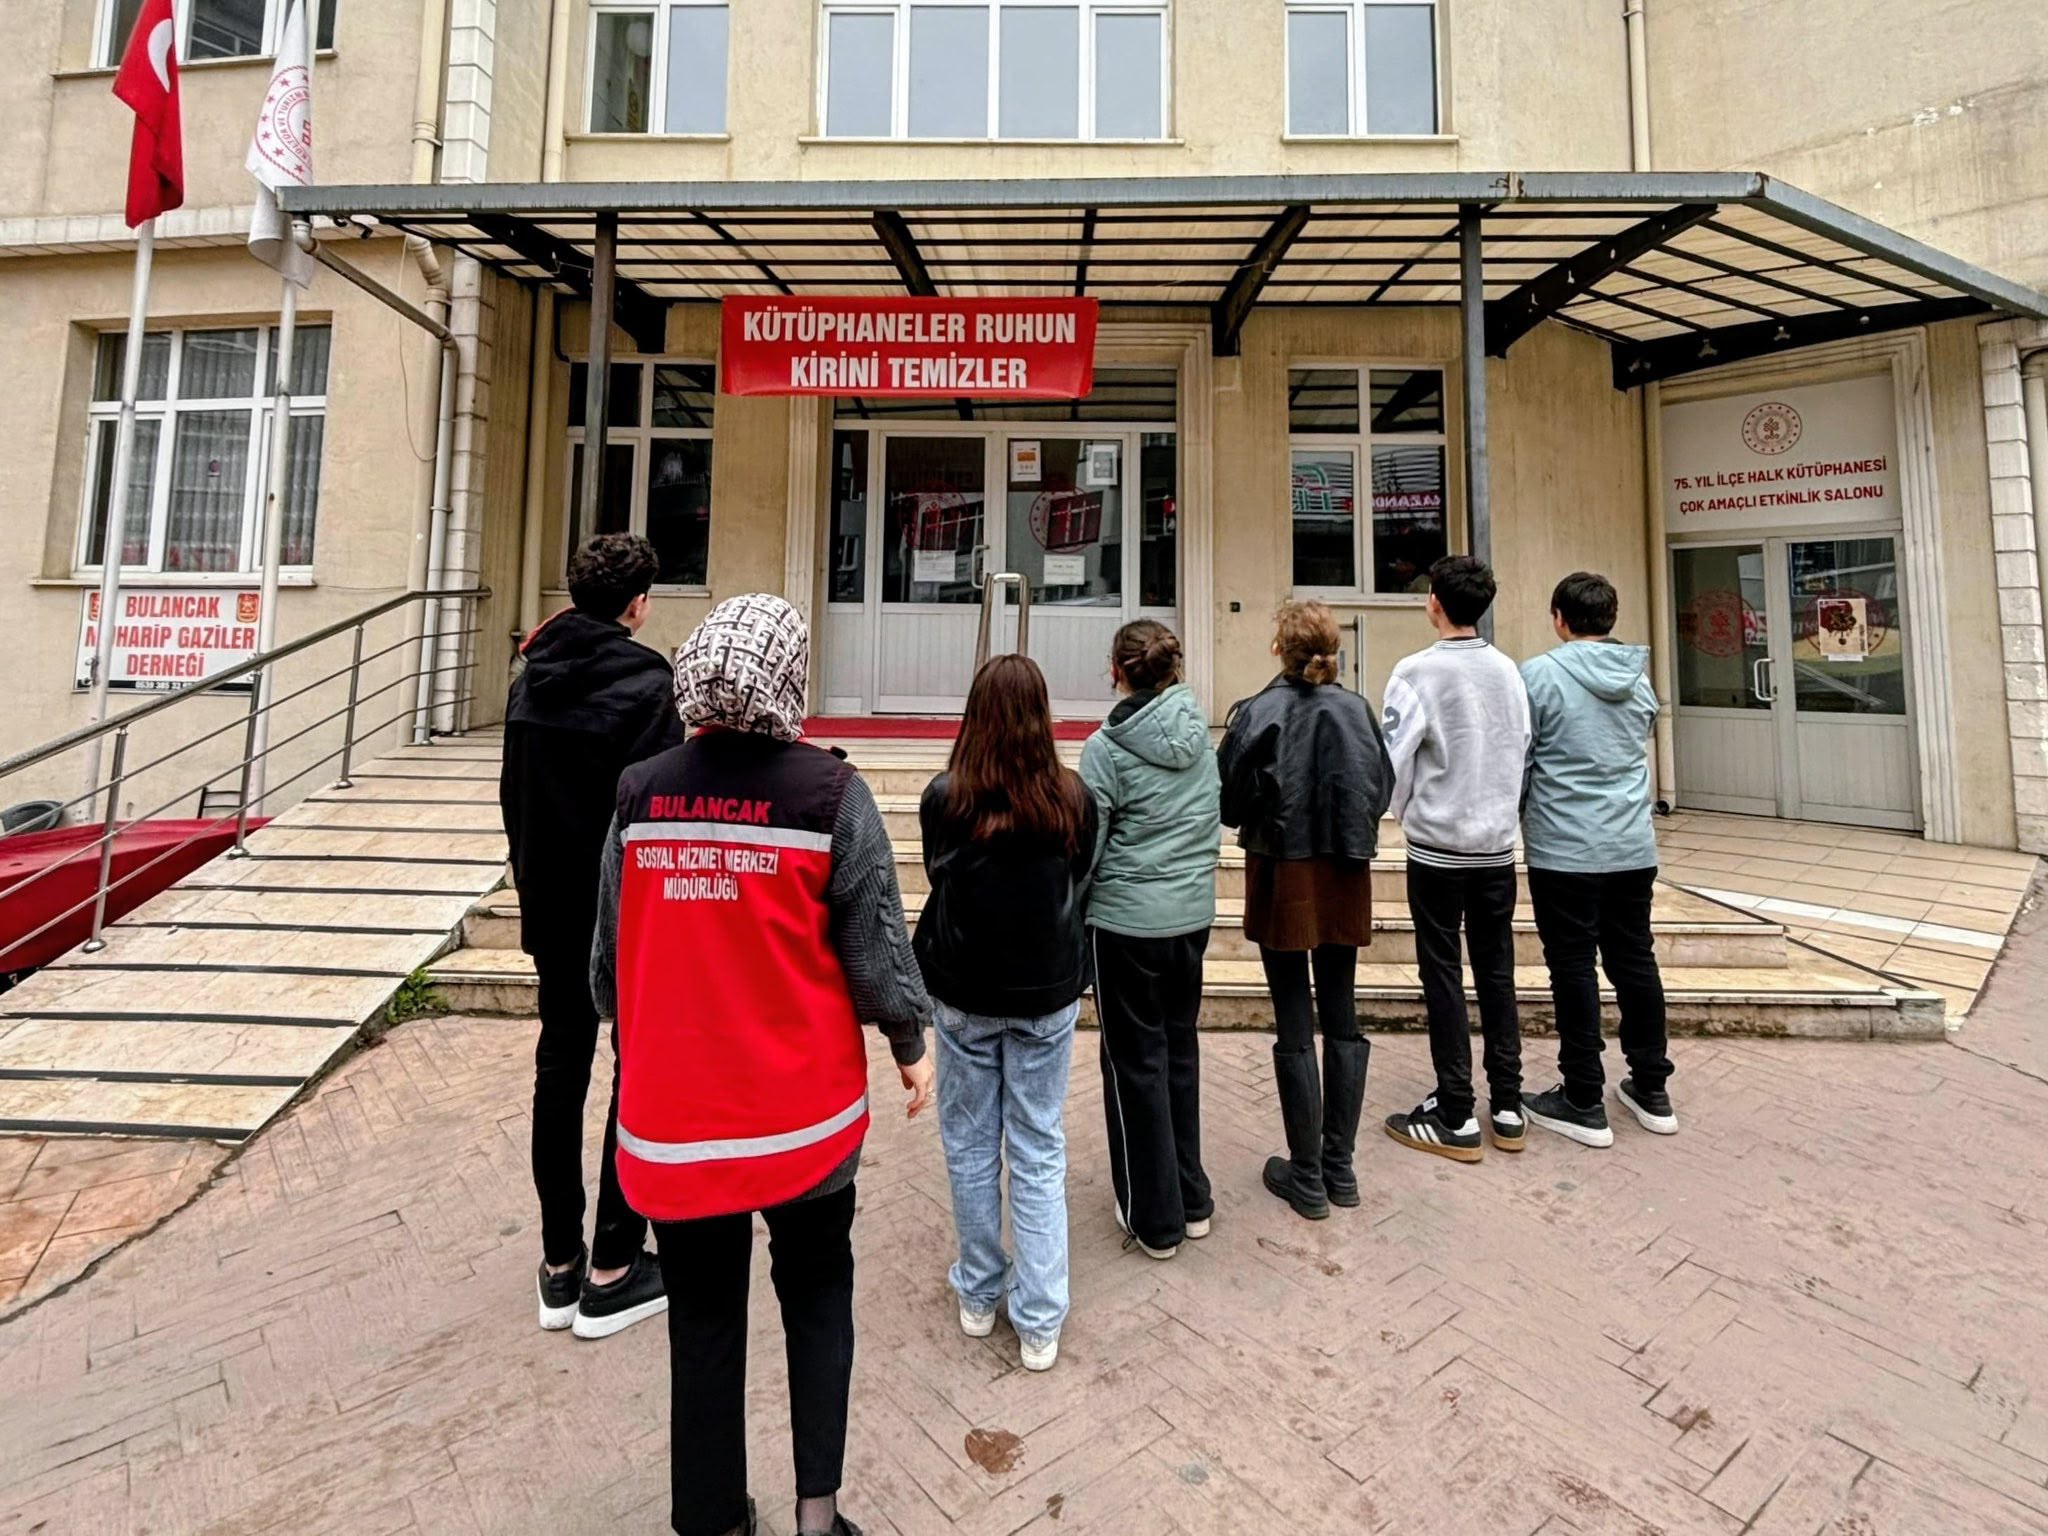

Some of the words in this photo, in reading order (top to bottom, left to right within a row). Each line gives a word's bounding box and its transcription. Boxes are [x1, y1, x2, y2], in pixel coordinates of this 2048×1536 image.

[743, 306, 966, 342] KÜTÜPHANELER
[975, 312, 1076, 343] RUHUN
[790, 351, 879, 388] KİRİNİ
[888, 351, 1027, 389] TEMİZLER
[1674, 478, 1692, 490] 75.
[1694, 475, 1714, 488] YIL
[1717, 471, 1745, 487] İLÇE
[1748, 468, 1783, 484] HALK
[1786, 455, 1888, 480] KÜTÜPHANESİ
[1680, 500, 1705, 515] ÇOK
[1707, 495, 1757, 511] AMAÇLI
[1759, 488, 1821, 507] ETKİNLİK
[1824, 484, 1884, 501] SALONU
[125, 595, 221, 618] BULANCAK
[84, 623, 172, 649] MHARİP
[177, 623, 256, 650] GAZİLER
[126, 652, 206, 677] DERNEĞİ
[649, 795, 773, 824] BULANCAK
[635, 846, 676, 870] SOSYAL
[677, 841, 723, 870] HİZMET
[724, 847, 780, 875] MERKEZİ
[663, 872, 739, 901] MÜDÜRLÜĞÜ
